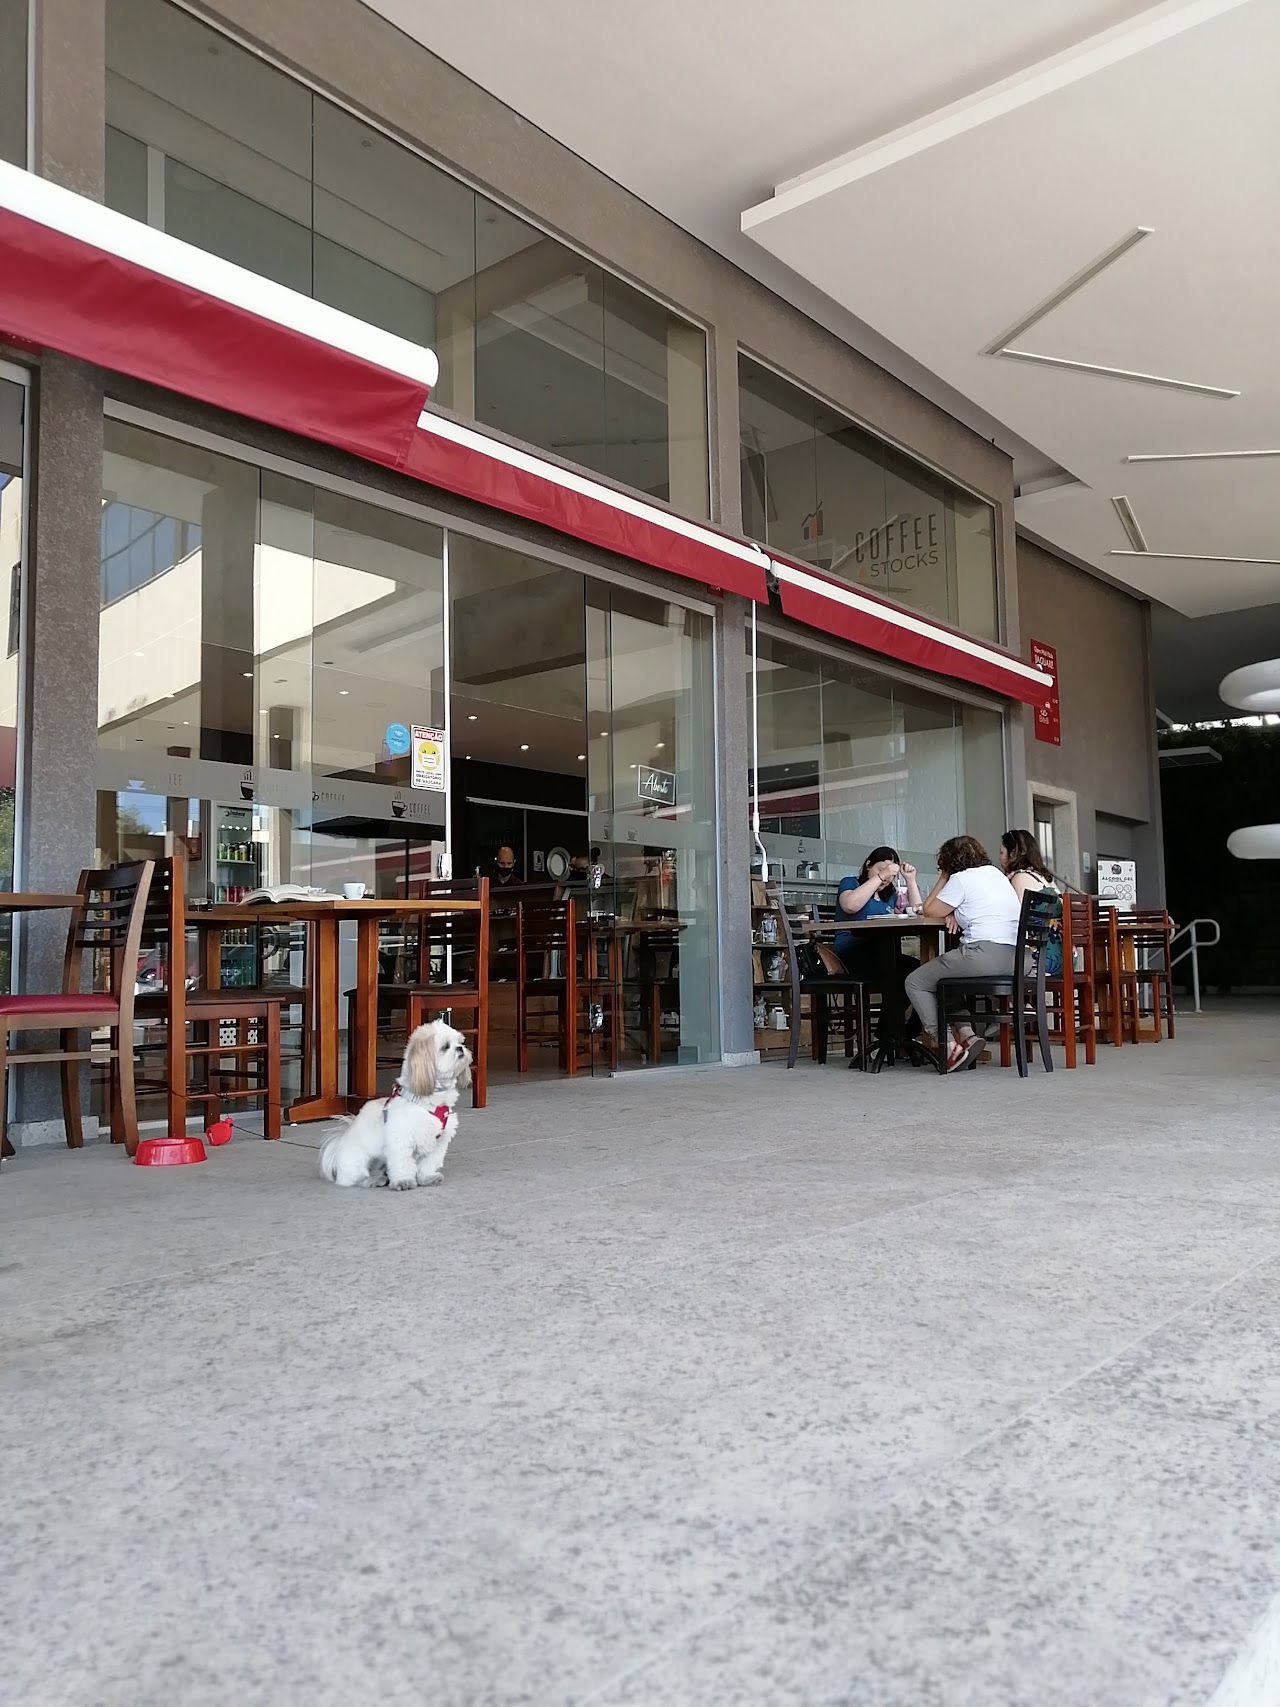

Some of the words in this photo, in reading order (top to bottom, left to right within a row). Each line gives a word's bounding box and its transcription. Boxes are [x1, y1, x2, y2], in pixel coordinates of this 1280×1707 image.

[856, 513, 938, 565] COFFEE
[870, 551, 938, 577] STOCKS
[415, 729, 443, 742] ATENÇÃO
